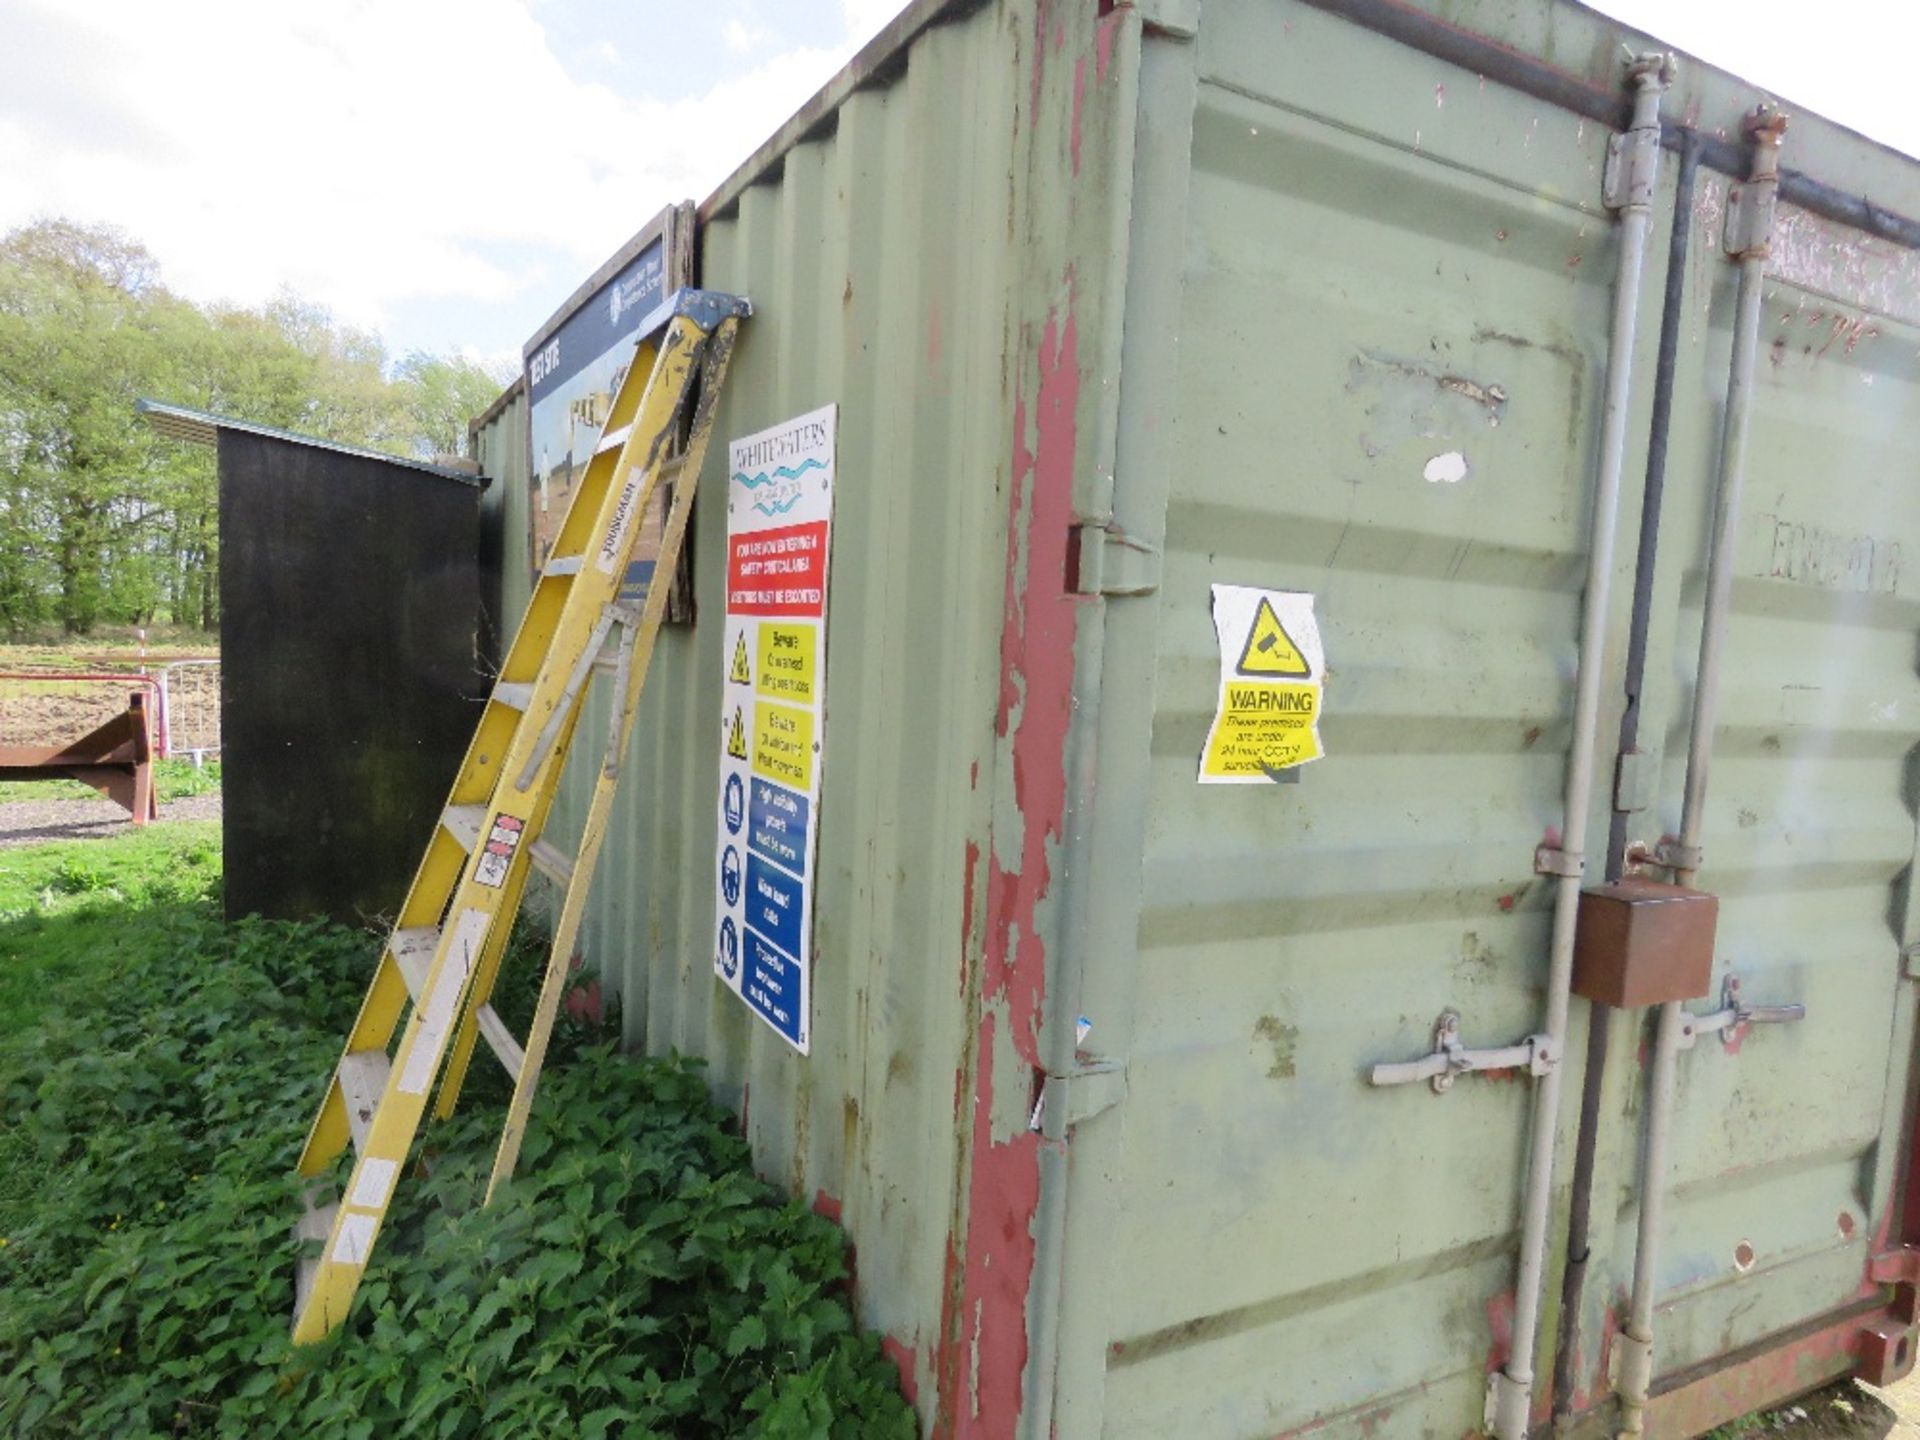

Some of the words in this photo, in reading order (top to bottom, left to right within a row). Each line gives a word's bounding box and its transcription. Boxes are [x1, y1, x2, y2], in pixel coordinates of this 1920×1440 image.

[737, 419, 826, 468] WHITEWATERS
[602, 482, 636, 560] YOUNGMAN
[1230, 689, 1313, 711] WARNING
